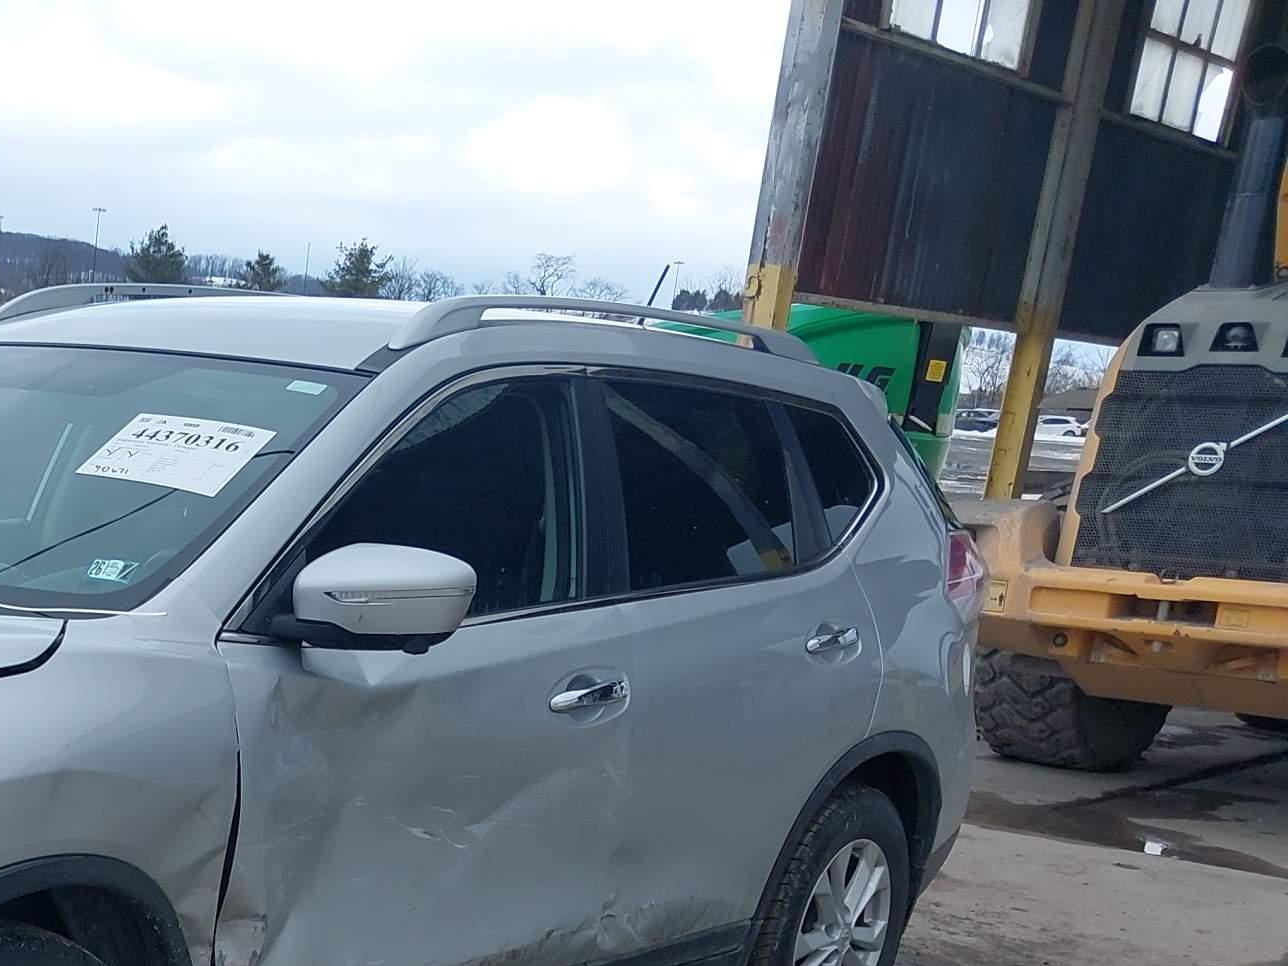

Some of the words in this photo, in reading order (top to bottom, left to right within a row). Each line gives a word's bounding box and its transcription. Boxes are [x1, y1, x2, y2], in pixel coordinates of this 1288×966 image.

[131, 427, 240, 453] 44370316
[1191, 455, 1222, 463] VOLVO
[89, 560, 106, 576] 26
